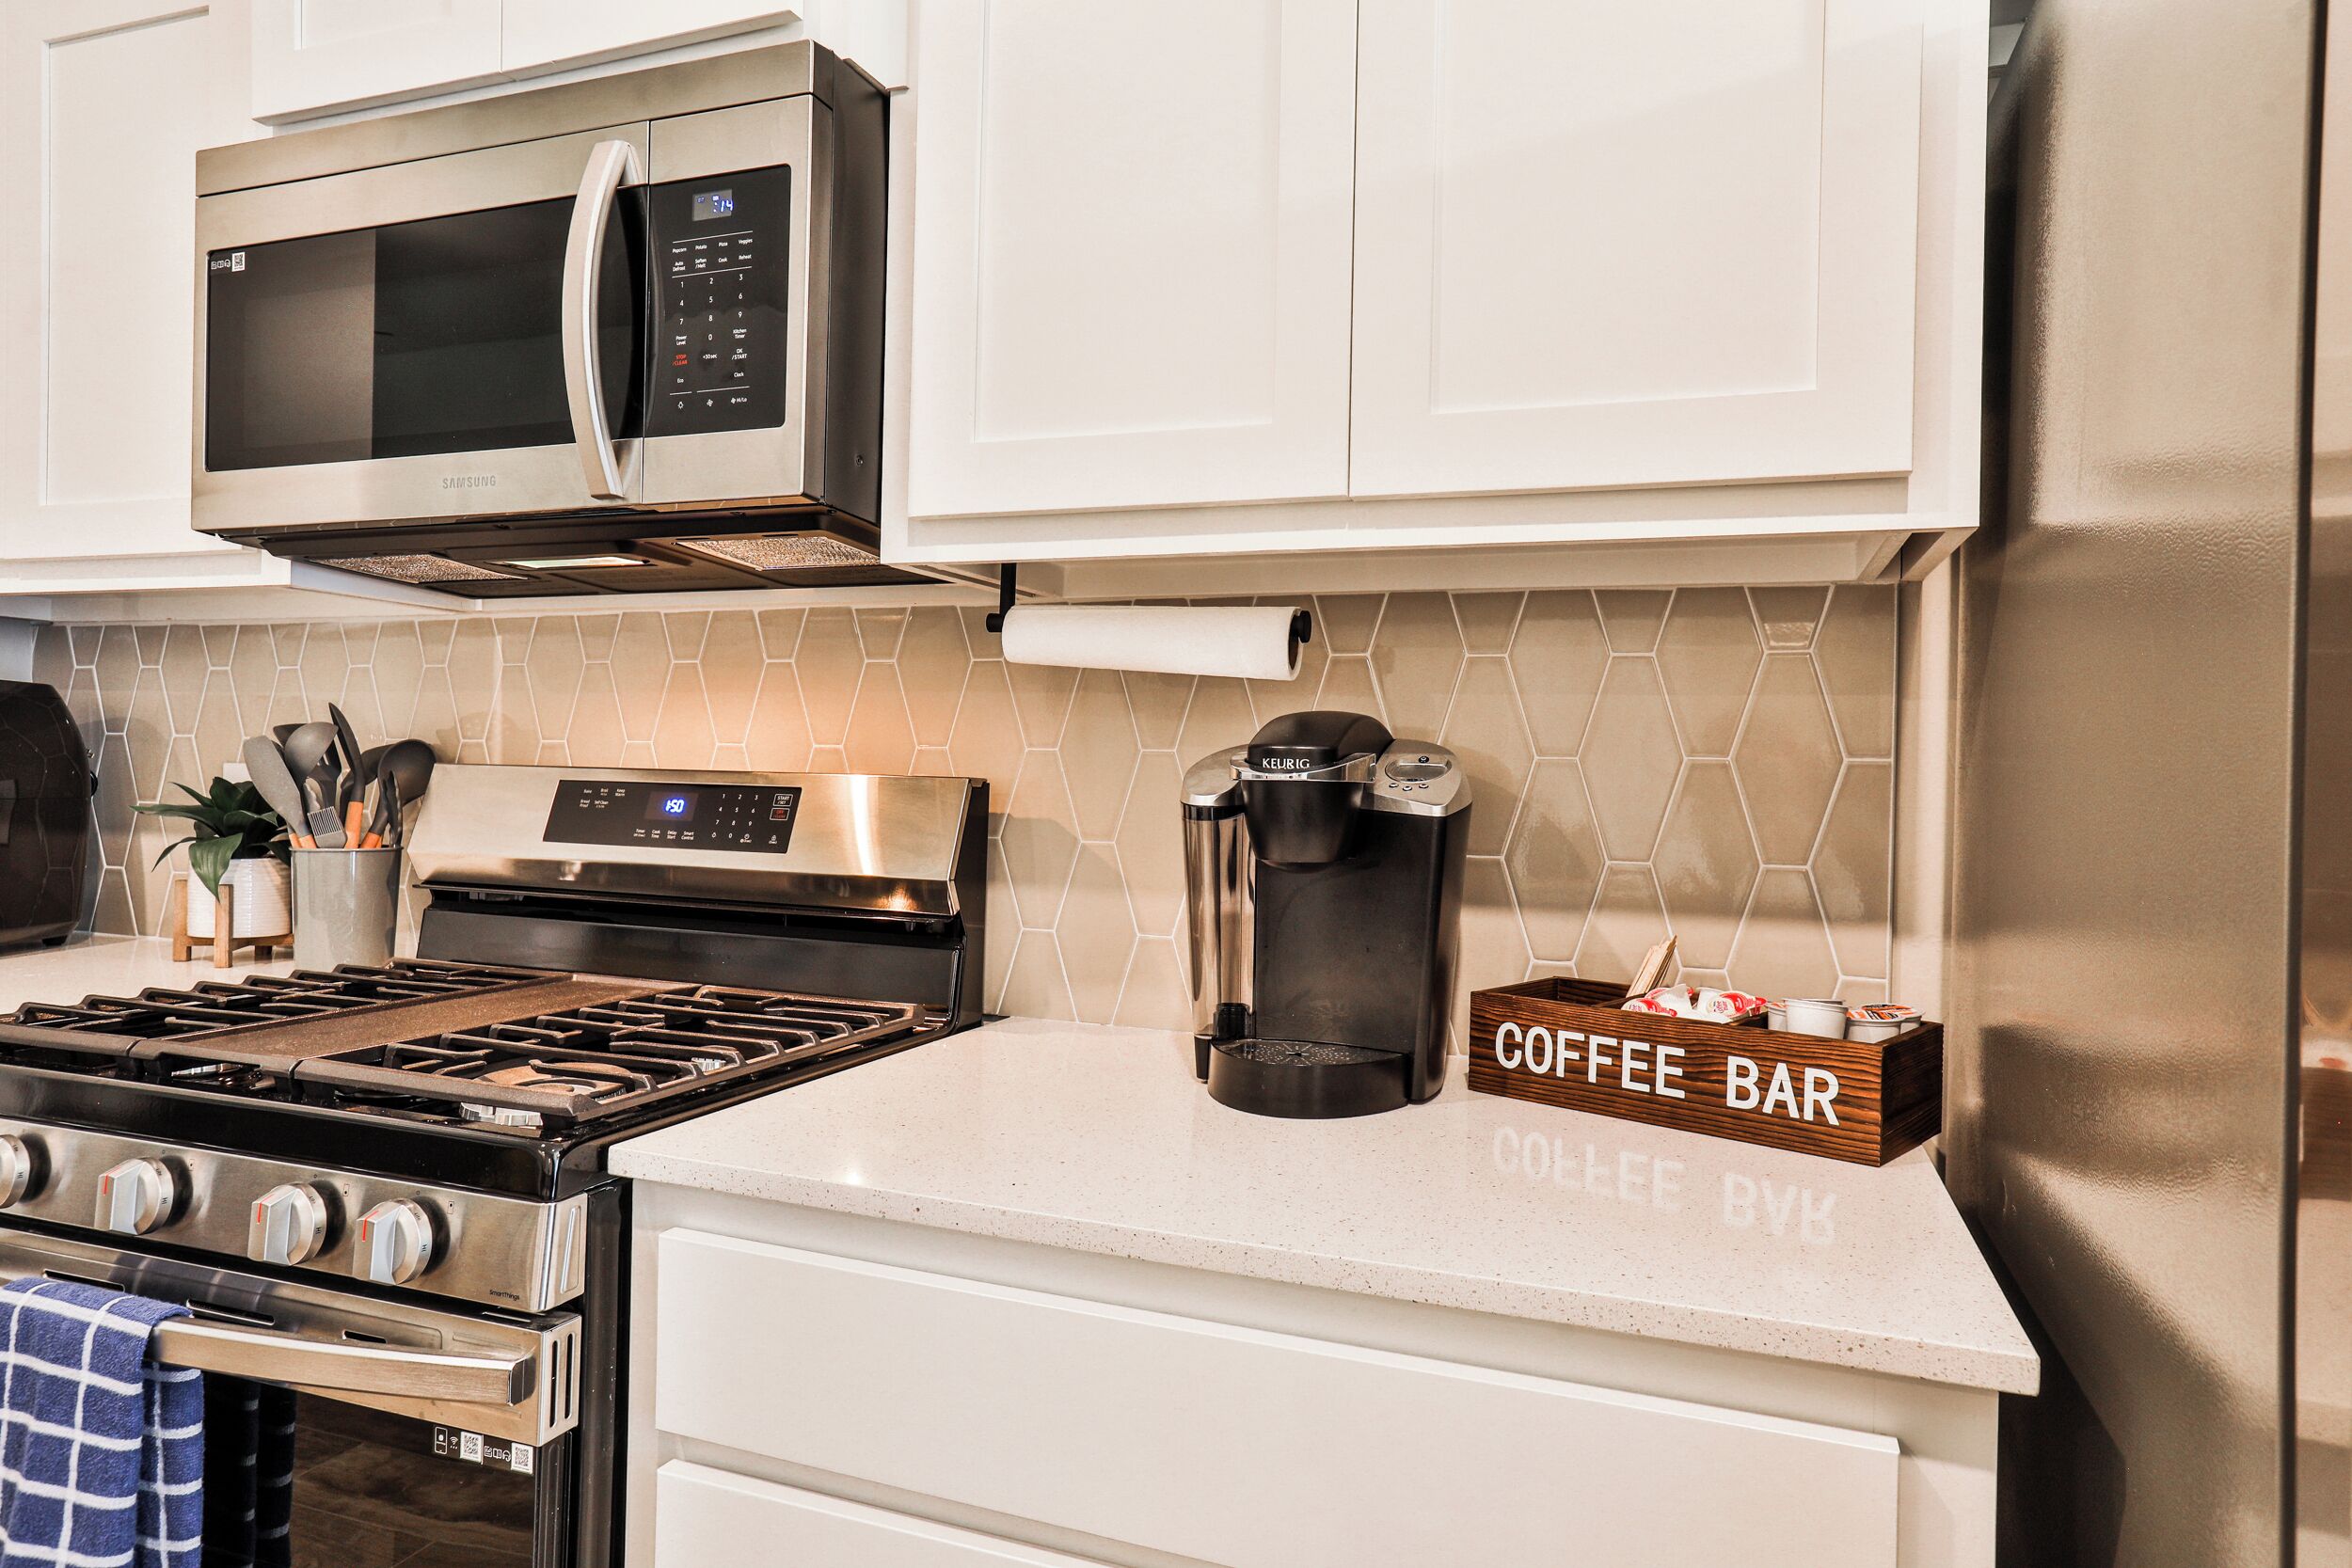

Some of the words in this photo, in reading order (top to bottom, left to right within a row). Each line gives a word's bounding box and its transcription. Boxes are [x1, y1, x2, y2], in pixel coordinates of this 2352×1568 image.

[442, 475, 496, 489] SAMSUNG
[1263, 758, 1310, 769] KEURIG
[1495, 1022, 1686, 1099] COFFEE
[1726, 1055, 1840, 1127] BAR
[489, 1289, 520, 1301] SmartThings
